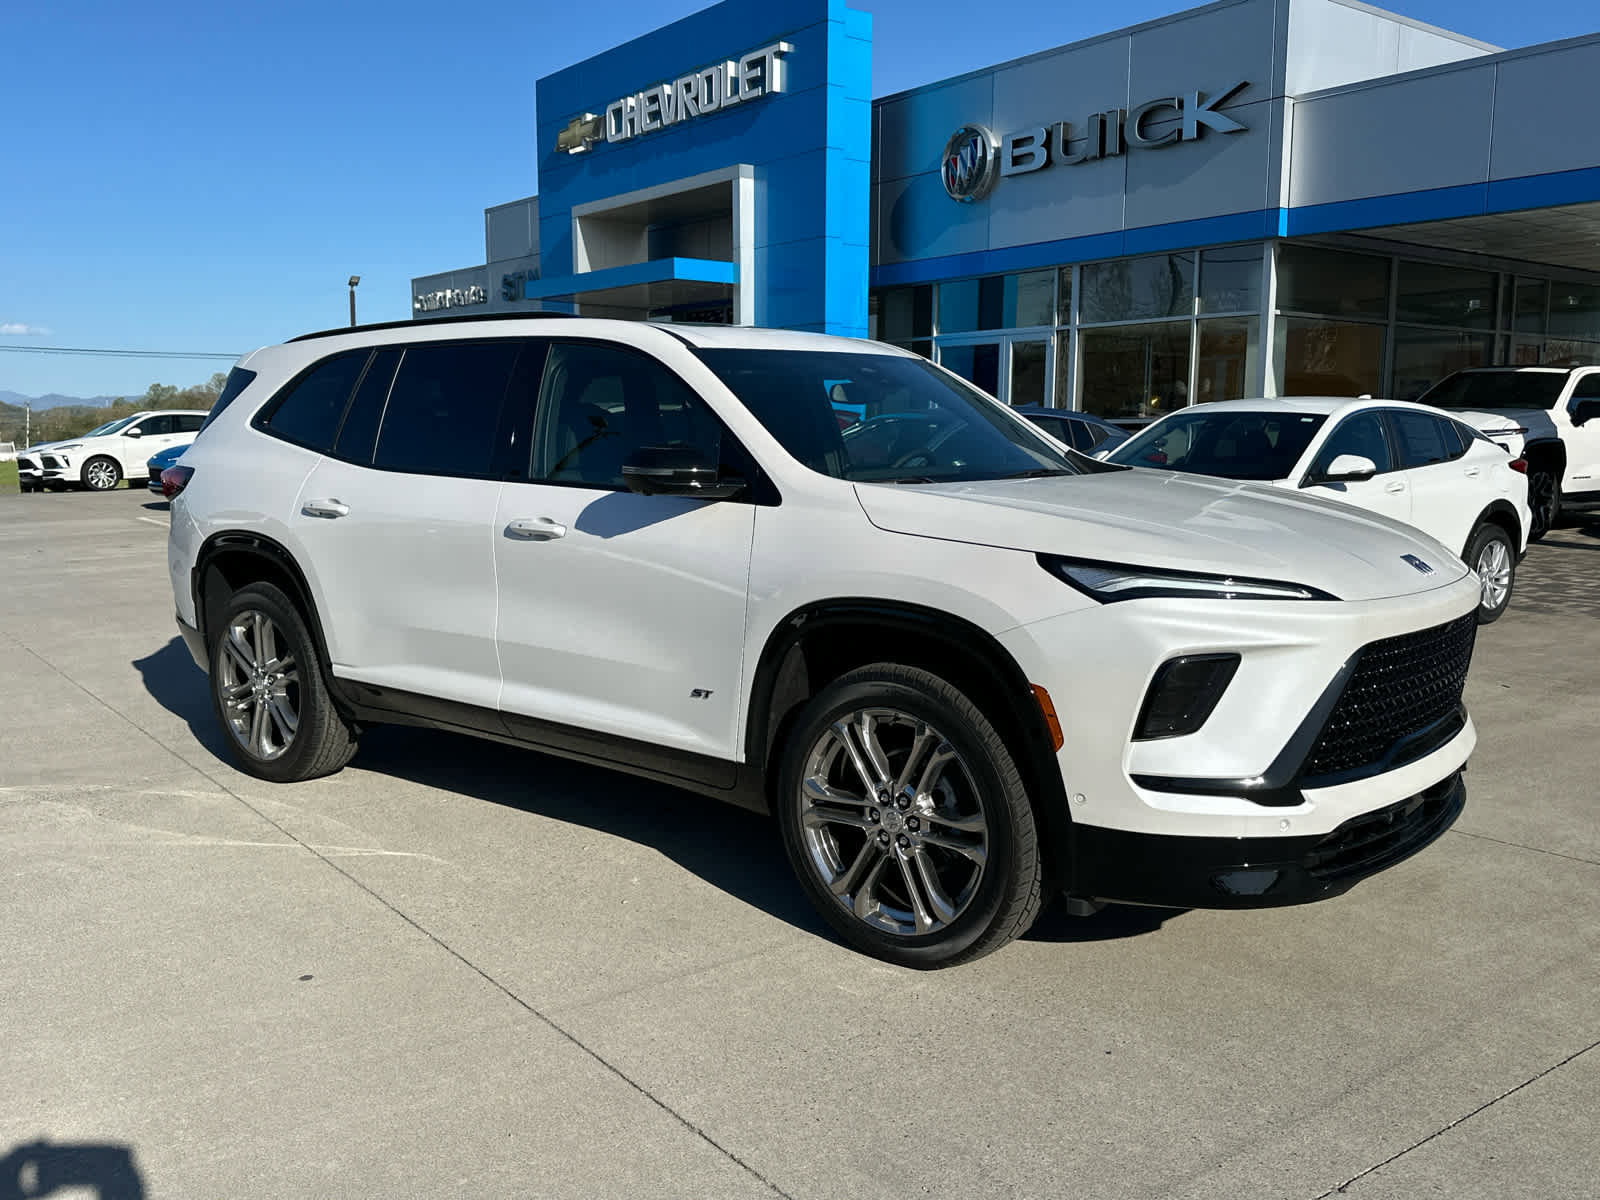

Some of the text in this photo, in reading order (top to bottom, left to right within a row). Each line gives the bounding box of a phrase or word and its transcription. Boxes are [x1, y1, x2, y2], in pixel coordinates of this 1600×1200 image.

[606, 40, 794, 143] CHEVROLET
[1000, 80, 1251, 177] BUICK
[690, 688, 714, 700] ST
